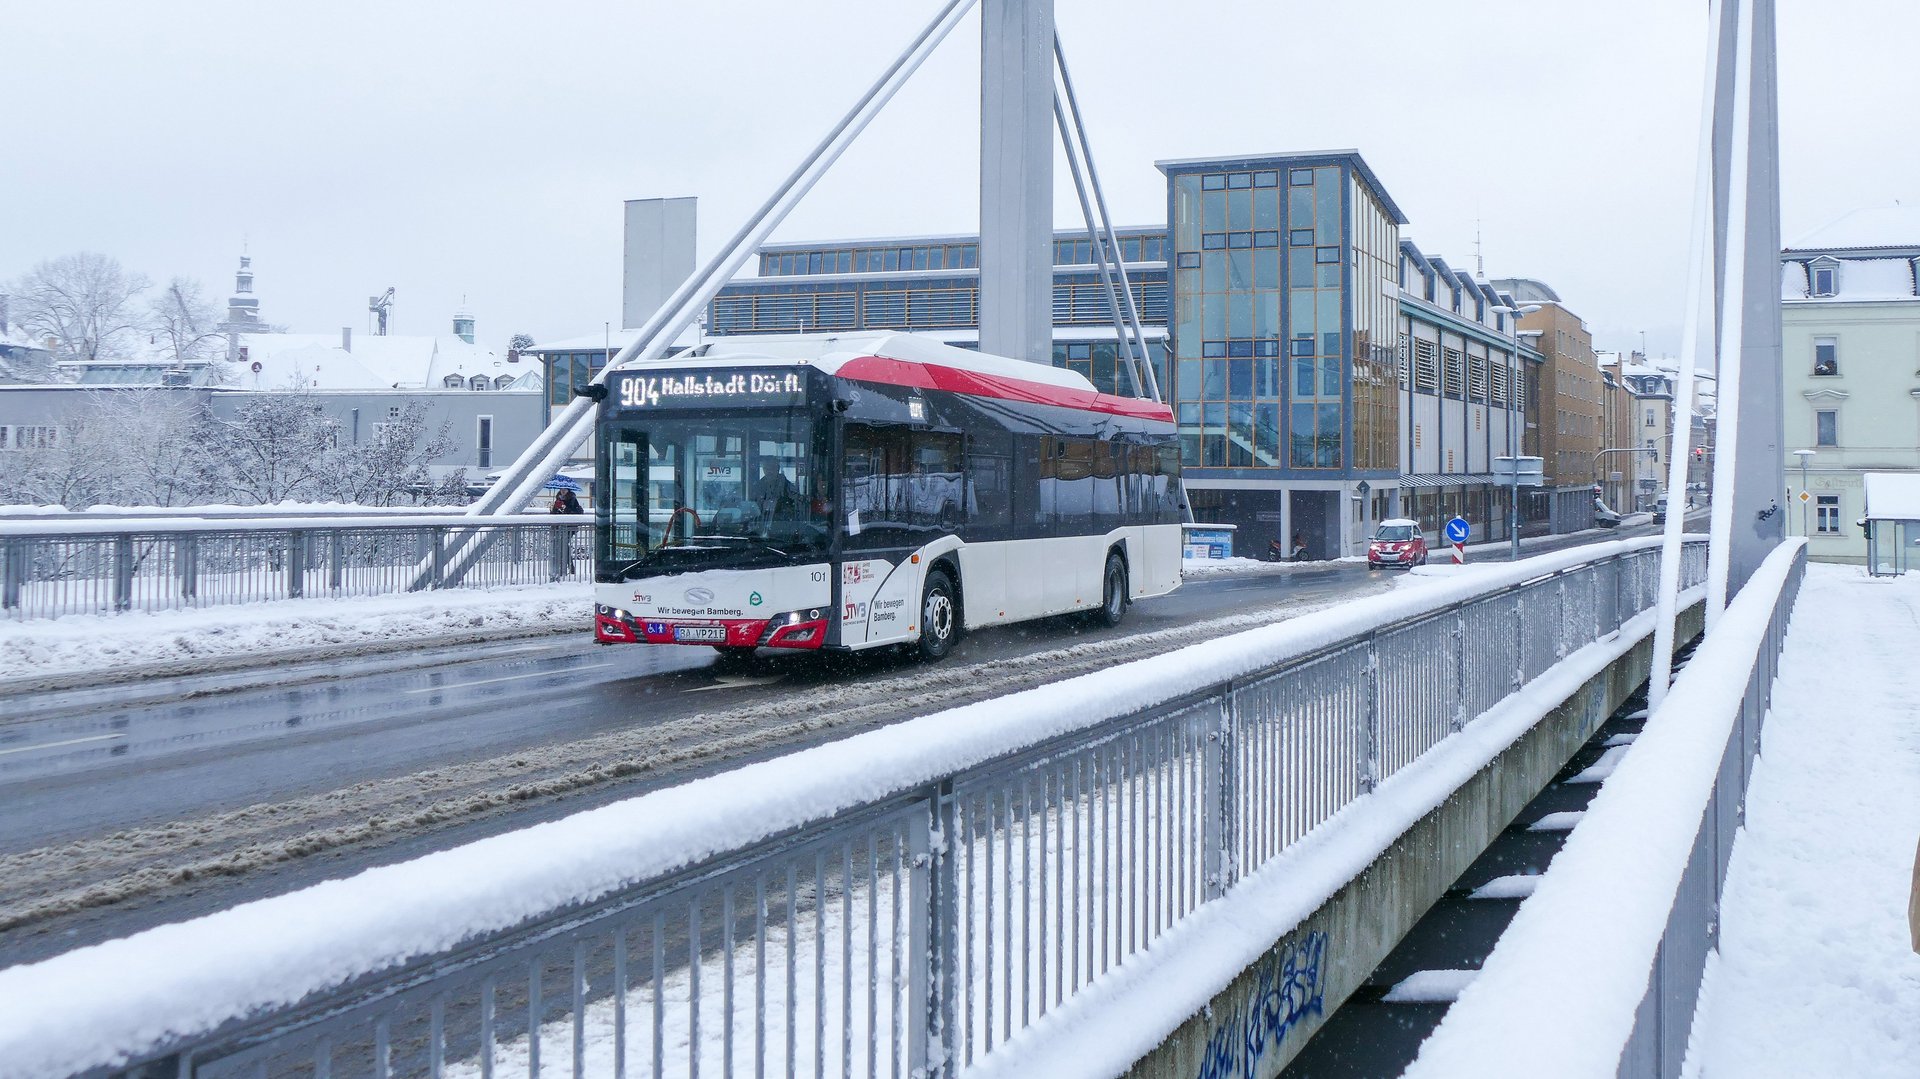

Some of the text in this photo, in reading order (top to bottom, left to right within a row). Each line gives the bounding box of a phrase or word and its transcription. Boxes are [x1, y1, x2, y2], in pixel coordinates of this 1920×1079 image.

[621, 374, 802, 406] 904 Hallstadt Dörfl.
[810, 572, 826, 581] 101
[874, 600, 904, 609] Wir bewegen
[672, 607, 705, 616] bewegen
[707, 608, 744, 617] Bamberg.
[874, 611, 896, 621] Bamberg.
